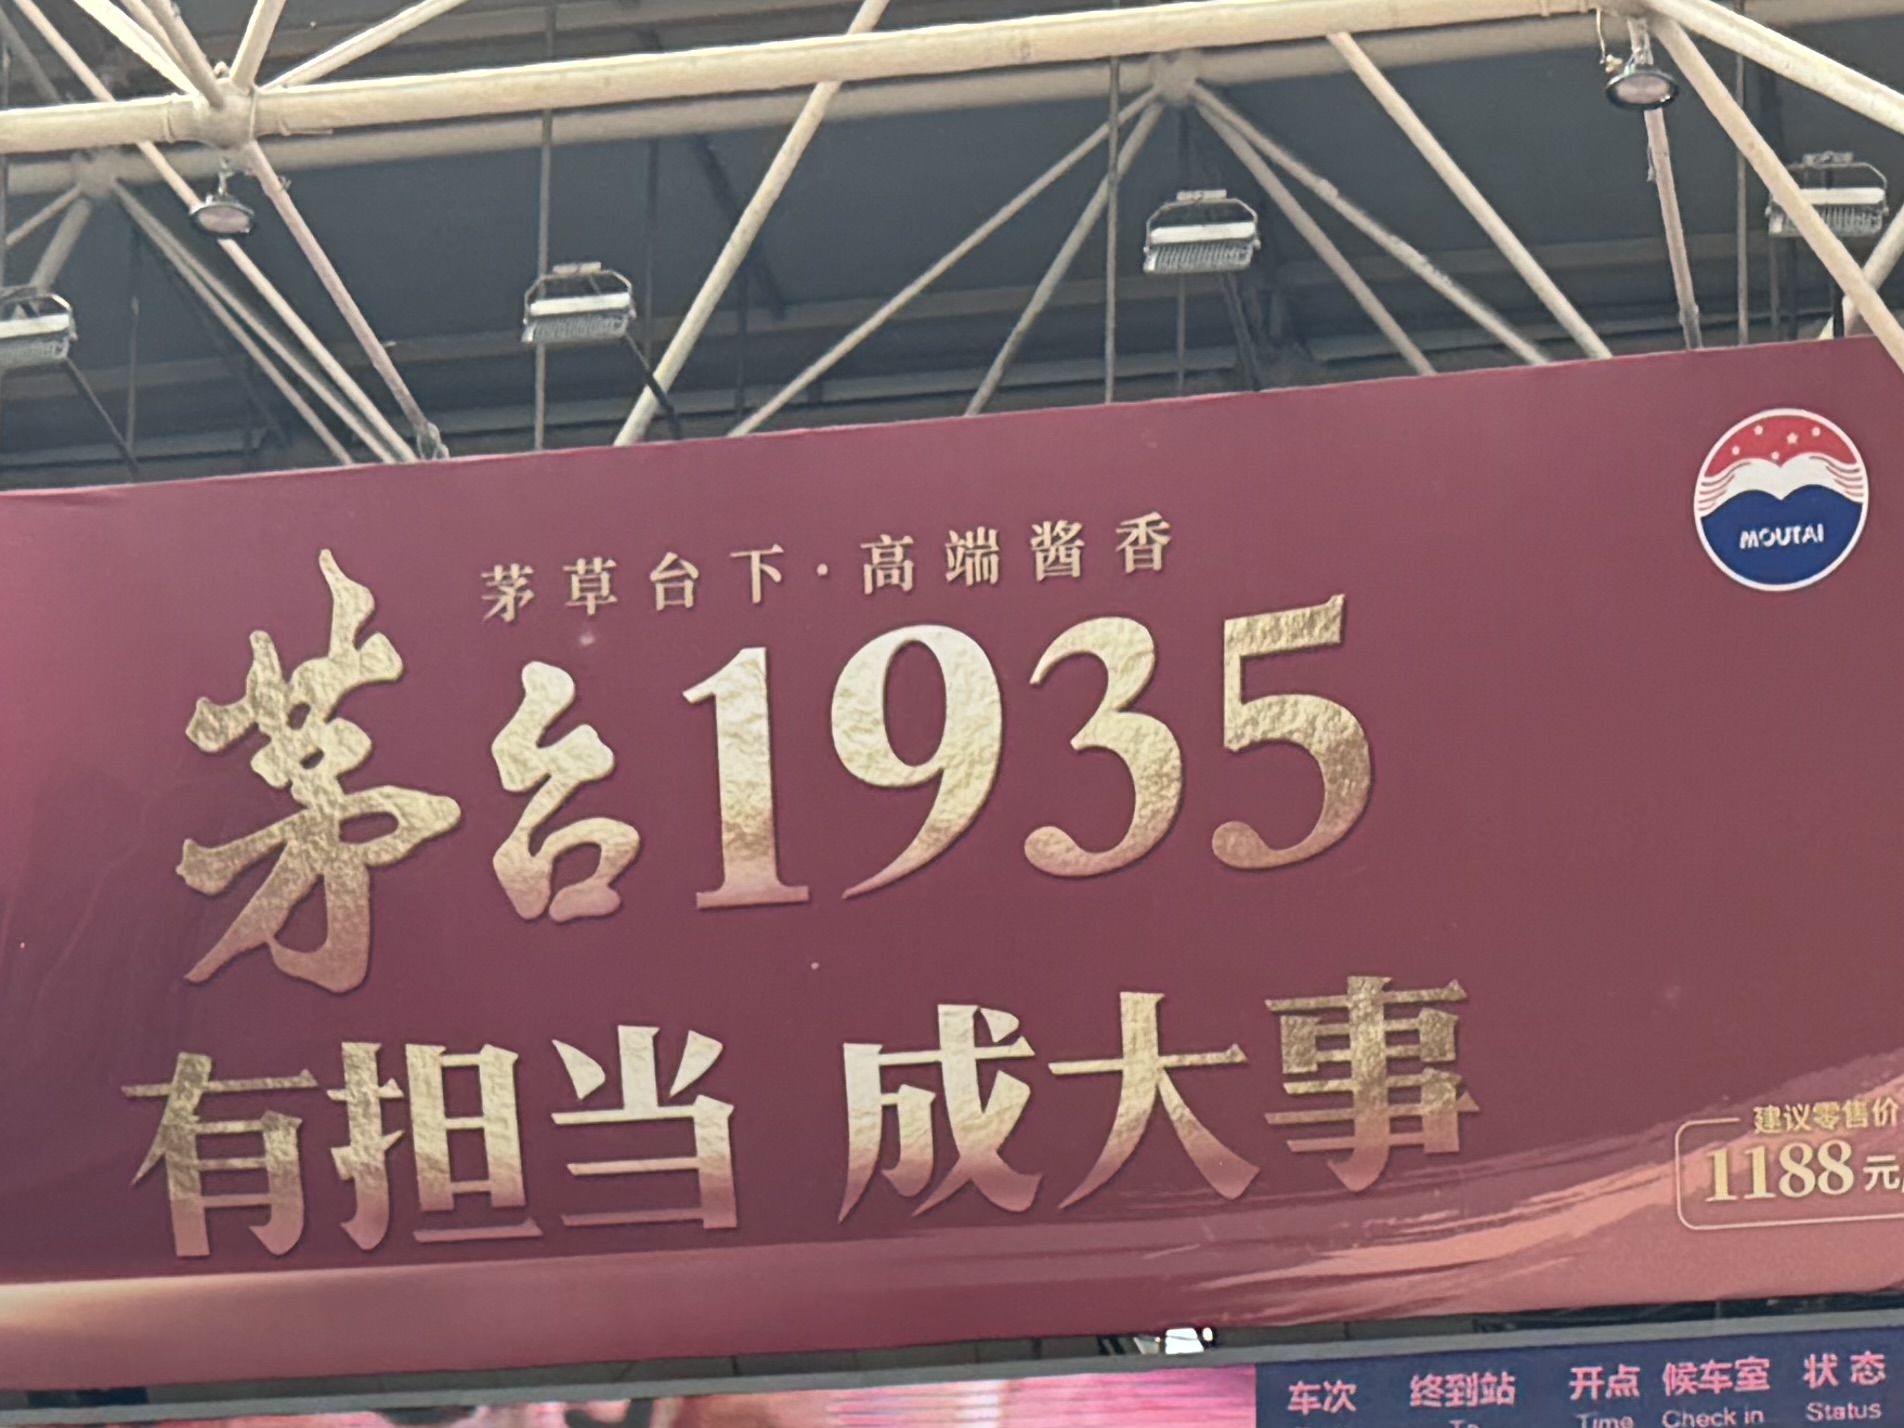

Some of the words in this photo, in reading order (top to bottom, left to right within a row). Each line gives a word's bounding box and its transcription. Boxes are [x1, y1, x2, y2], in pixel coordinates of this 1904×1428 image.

[481, 511, 1172, 623] 茅草台下·高端酱香
[1740, 523, 1824, 549] MOUTAI
[176, 548, 1373, 996] 茅台1935
[121, 1025, 738, 1258] 有担当
[838, 976, 1480, 1225] 成大事
[1753, 1097, 1901, 1135] 建议零售价
